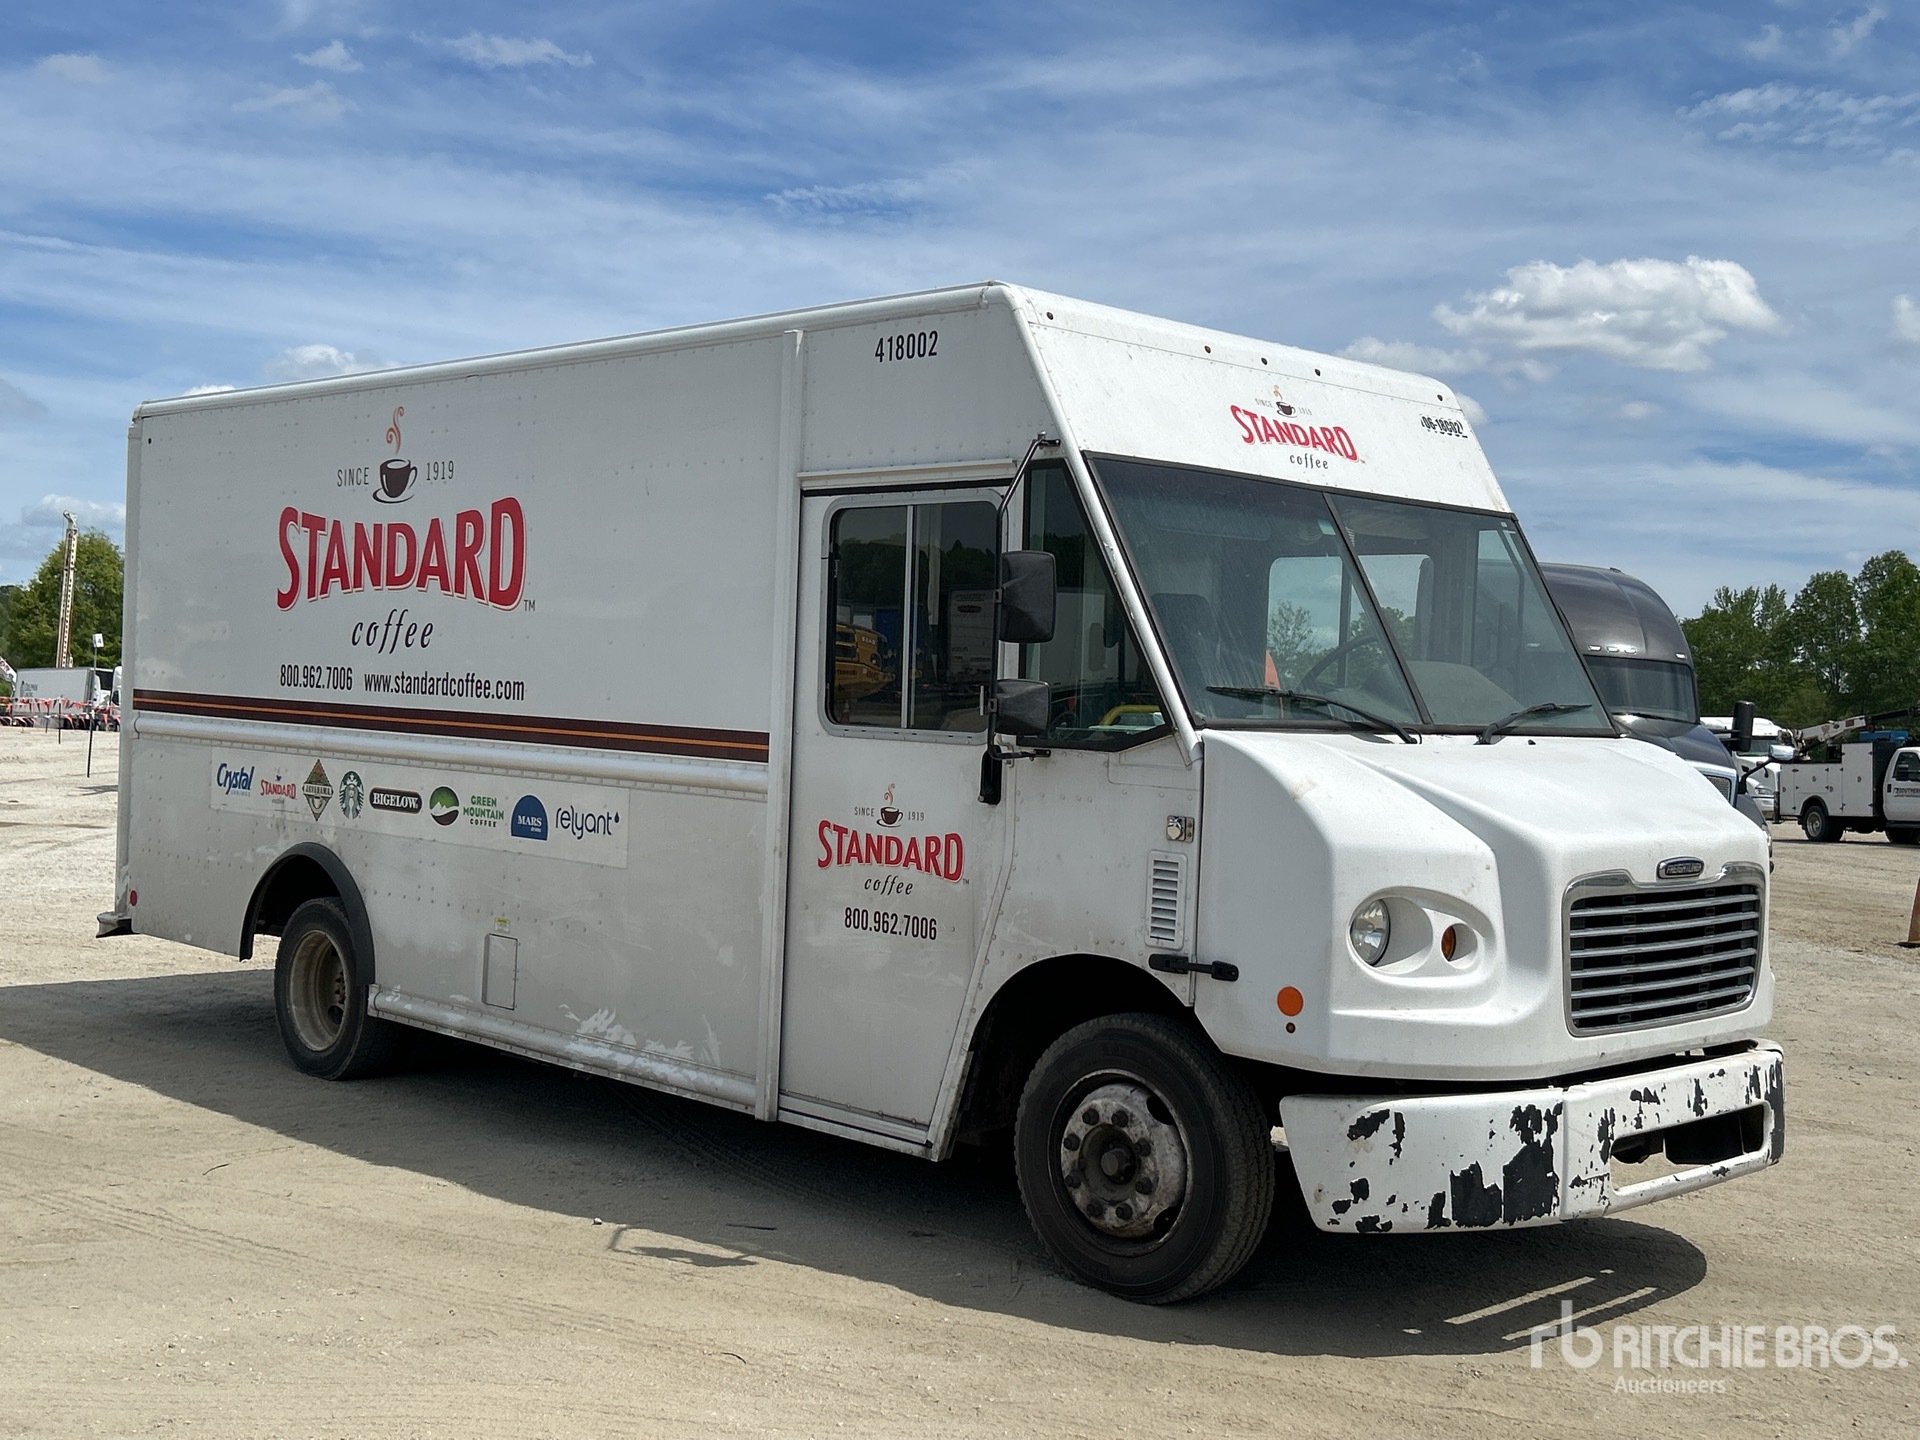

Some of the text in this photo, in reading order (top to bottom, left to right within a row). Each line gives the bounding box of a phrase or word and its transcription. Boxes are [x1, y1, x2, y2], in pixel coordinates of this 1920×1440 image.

[875, 330, 938, 363] 418002
[1230, 404, 1359, 462] STANDARD
[337, 460, 455, 487] SINCE 1919
[1289, 453, 1329, 469] coffee
[276, 497, 527, 612] STANDARD
[351, 608, 435, 654] coffee
[280, 664, 525, 701] 800.962.7006 www.standardcoffee.com
[216, 762, 255, 796] Crystal
[260, 779, 297, 800] STANDARD
[372, 792, 419, 809] BIGELOW
[463, 806, 504, 820] MOUNTAIN
[470, 795, 497, 807] GREEN
[854, 806, 925, 821] SINCE 1919
[470, 818, 497, 828] COFFEE
[517, 815, 542, 827] MARS
[555, 804, 613, 840] relyant
[817, 819, 964, 884] STANDARD
[864, 874, 914, 896] coffee
[844, 906, 938, 941] 800.962.7006
